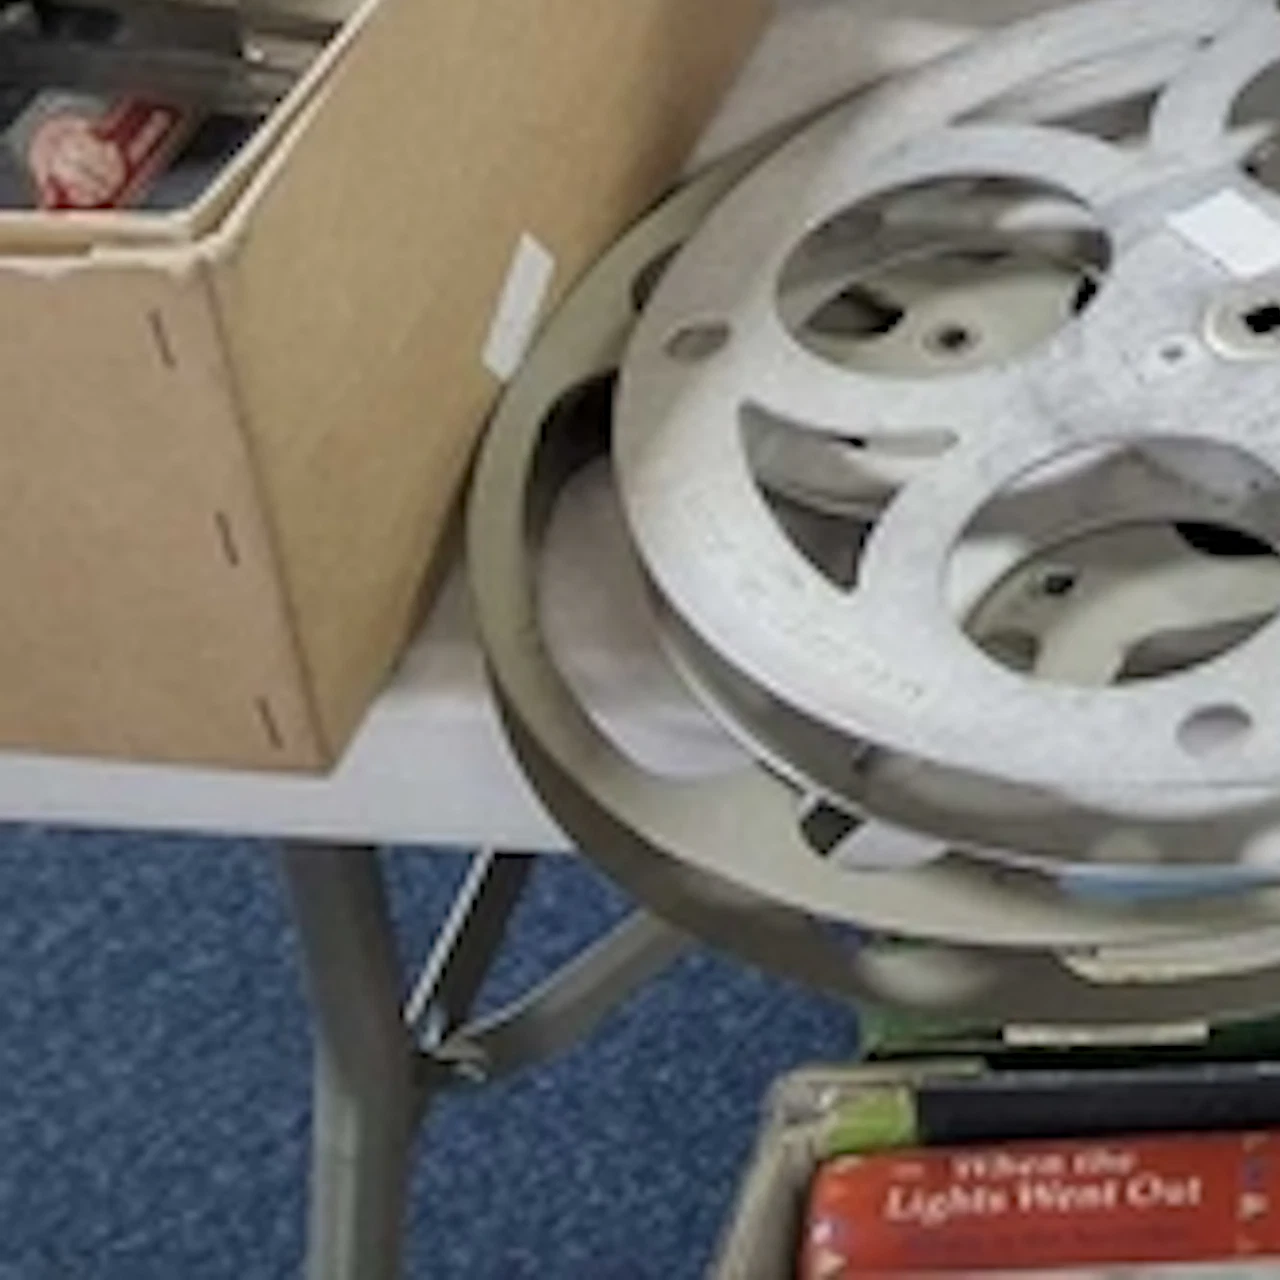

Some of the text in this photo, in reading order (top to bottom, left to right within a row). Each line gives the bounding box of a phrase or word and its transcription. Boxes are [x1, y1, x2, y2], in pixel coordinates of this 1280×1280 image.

[953, 1146, 1138, 1180] When the
[882, 1174, 1202, 1226] Lights Went Out
